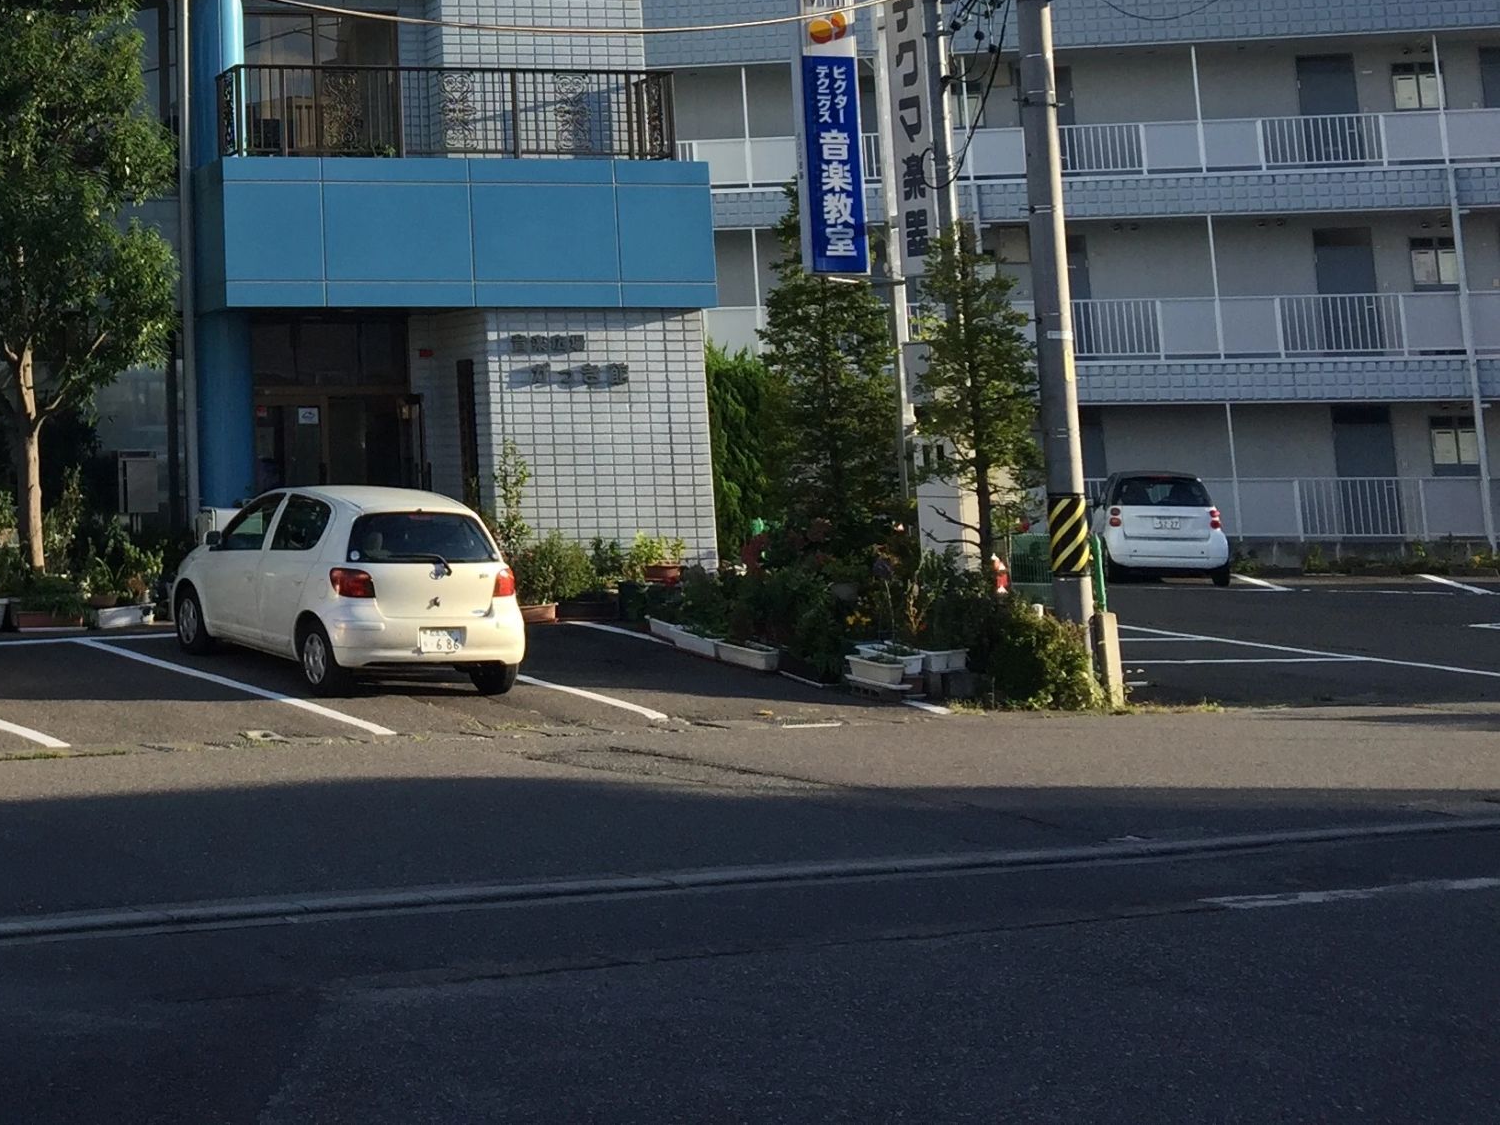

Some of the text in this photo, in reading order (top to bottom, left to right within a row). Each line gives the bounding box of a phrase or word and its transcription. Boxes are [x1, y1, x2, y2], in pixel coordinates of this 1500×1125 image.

[816, 65, 832, 124] テクニクス
[833, 65, 848, 124] ビクター
[819, 128, 857, 257] 音楽教室
[510, 334, 585, 353] 音楽広場
[531, 362, 629, 385] がっき館
